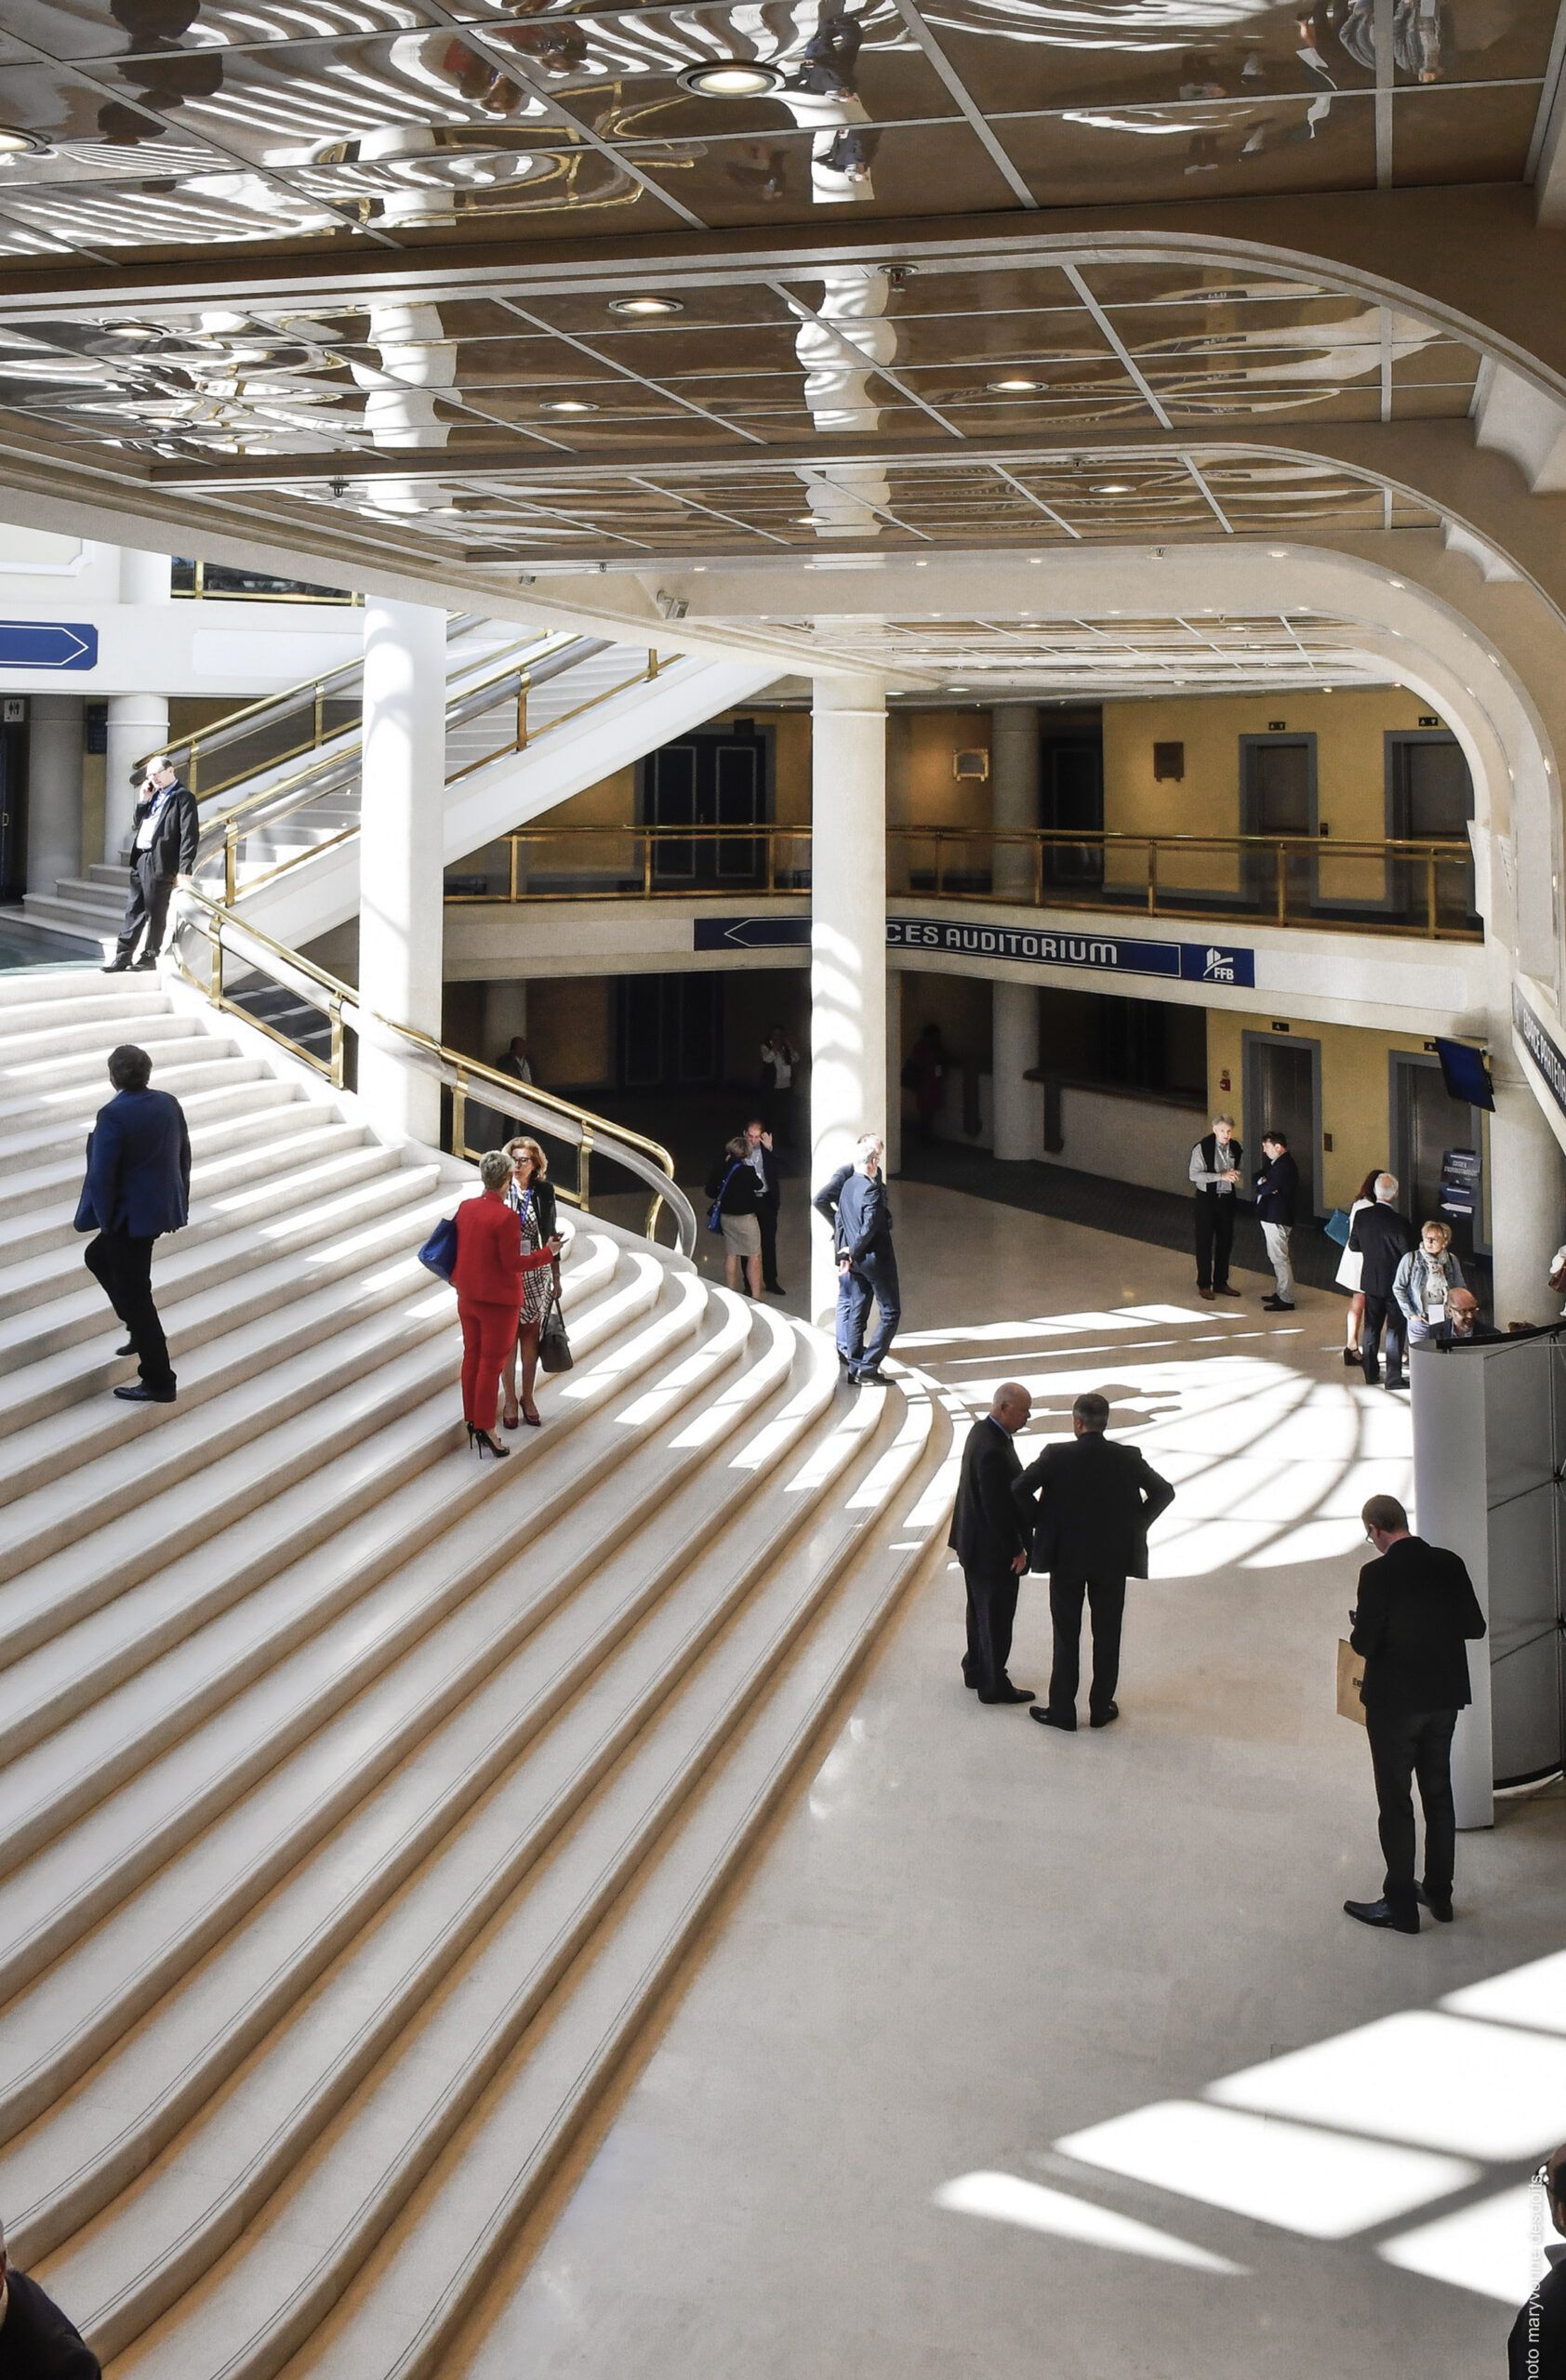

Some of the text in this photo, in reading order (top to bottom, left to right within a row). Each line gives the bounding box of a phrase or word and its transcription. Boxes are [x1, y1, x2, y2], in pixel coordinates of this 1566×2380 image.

[886, 923, 1117, 964] CES AUDITORIUM
[1214, 967, 1234, 981] FFB
